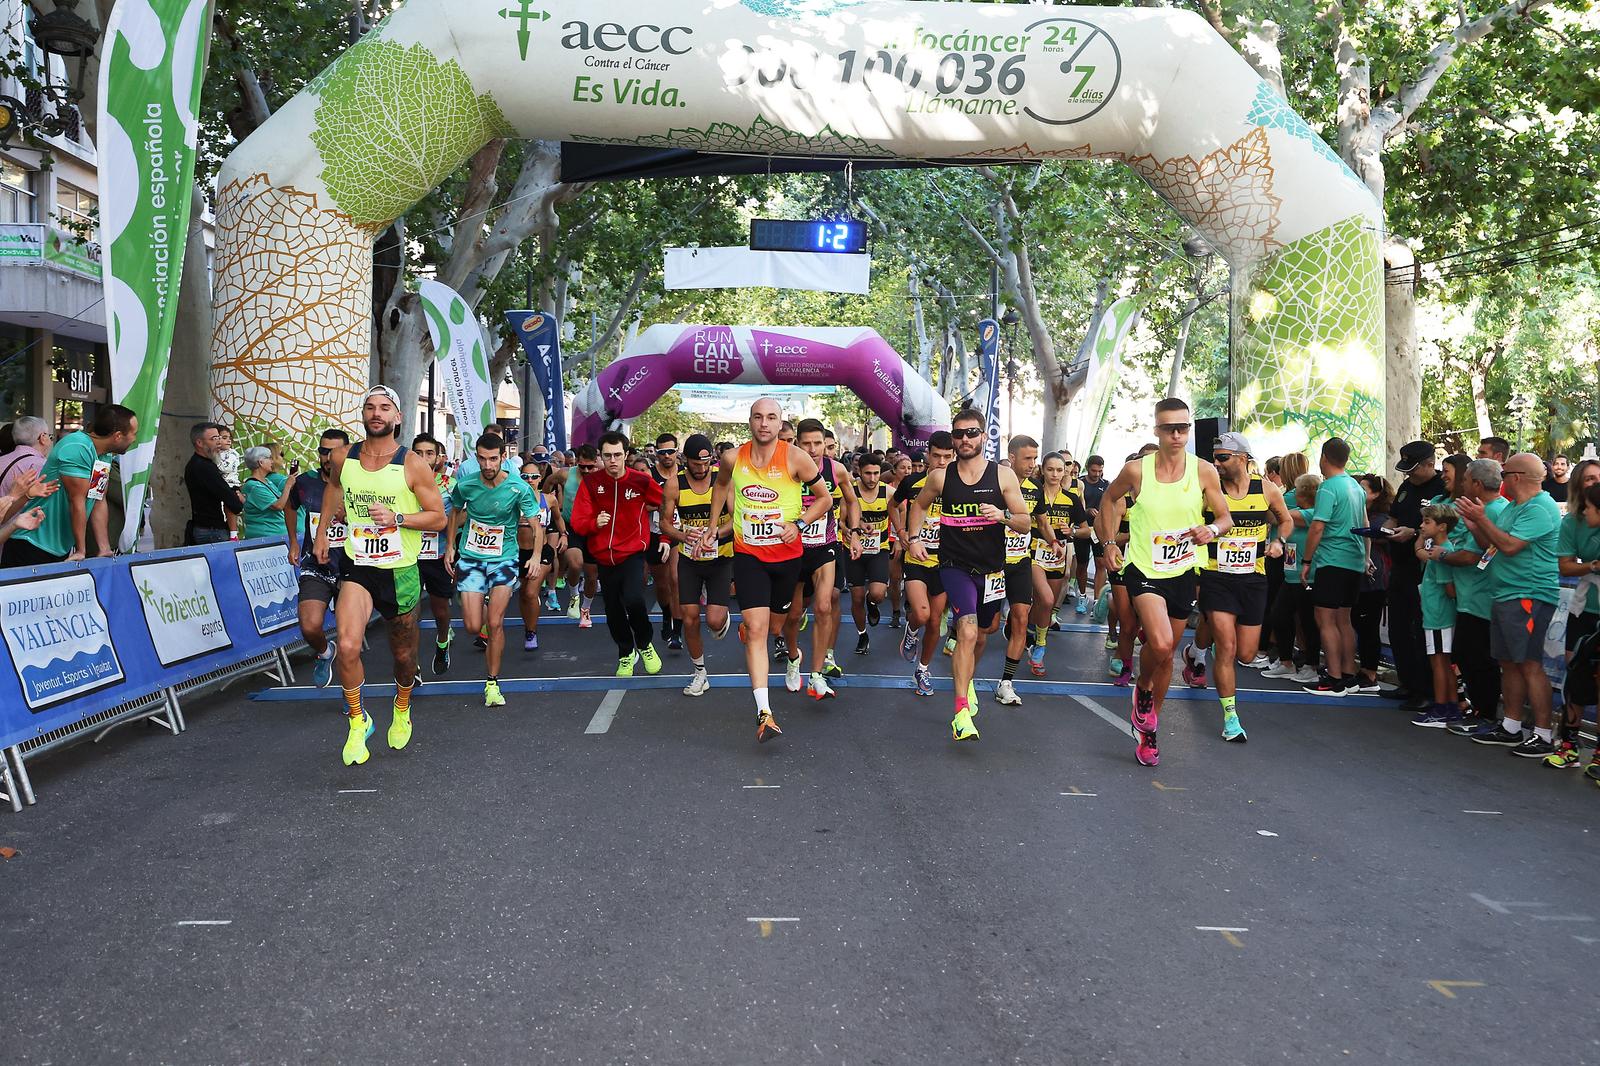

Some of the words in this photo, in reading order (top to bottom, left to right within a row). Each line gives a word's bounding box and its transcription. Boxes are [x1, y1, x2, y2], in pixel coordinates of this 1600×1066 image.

[561, 20, 693, 55] aecc
[883, 27, 1031, 53] focáncer
[1043, 25, 1078, 46] 24
[583, 55, 620, 69] Contra
[622, 57, 633, 69] el
[634, 58, 671, 71] Cáncer
[935, 52, 1027, 96] 036
[1069, 65, 1096, 98] 7
[572, 75, 604, 103] Es
[613, 77, 686, 108] Vida.
[1081, 89, 1104, 99] días
[905, 92, 1020, 115] Llámame.
[142, 103, 169, 209] española
[818, 224, 849, 250] 1:2
[695, 330, 732, 344] RUN
[774, 345, 808, 355] aecc
[693, 359, 731, 375] CER
[70, 368, 94, 393] SAIT
[622, 366, 649, 392] aecc
[873, 365, 902, 396] València
[905, 438, 929, 447] Valènc
[983, 412, 1001, 462] RROZ
[377, 495, 396, 505] SANZ
[745, 489, 776, 499] Serrano
[750, 523, 774, 536] 1113
[802, 523, 820, 535] 211
[918, 527, 940, 540] 330
[364, 538, 389, 554] 1118
[421, 540, 431, 551] 71
[474, 533, 497, 546] 1302
[859, 538, 876, 548] 282
[1041, 550, 1059, 561] 132
[1162, 540, 1189, 560] 1272
[1225, 550, 1251, 563] 1359
[243, 557, 278, 572] DIPUTACIÓ
[277, 555, 289, 566] DE
[246, 569, 296, 596] VALÈNCIA
[8, 589, 75, 617] DIPUTACIÓ
[77, 588, 92, 604] DE
[153, 589, 210, 625] València
[9, 610, 105, 653] VALÈNCIA
[201, 619, 223, 638] esports
[31, 676, 64, 698] Joventut,
[61, 667, 89, 686] Esports
